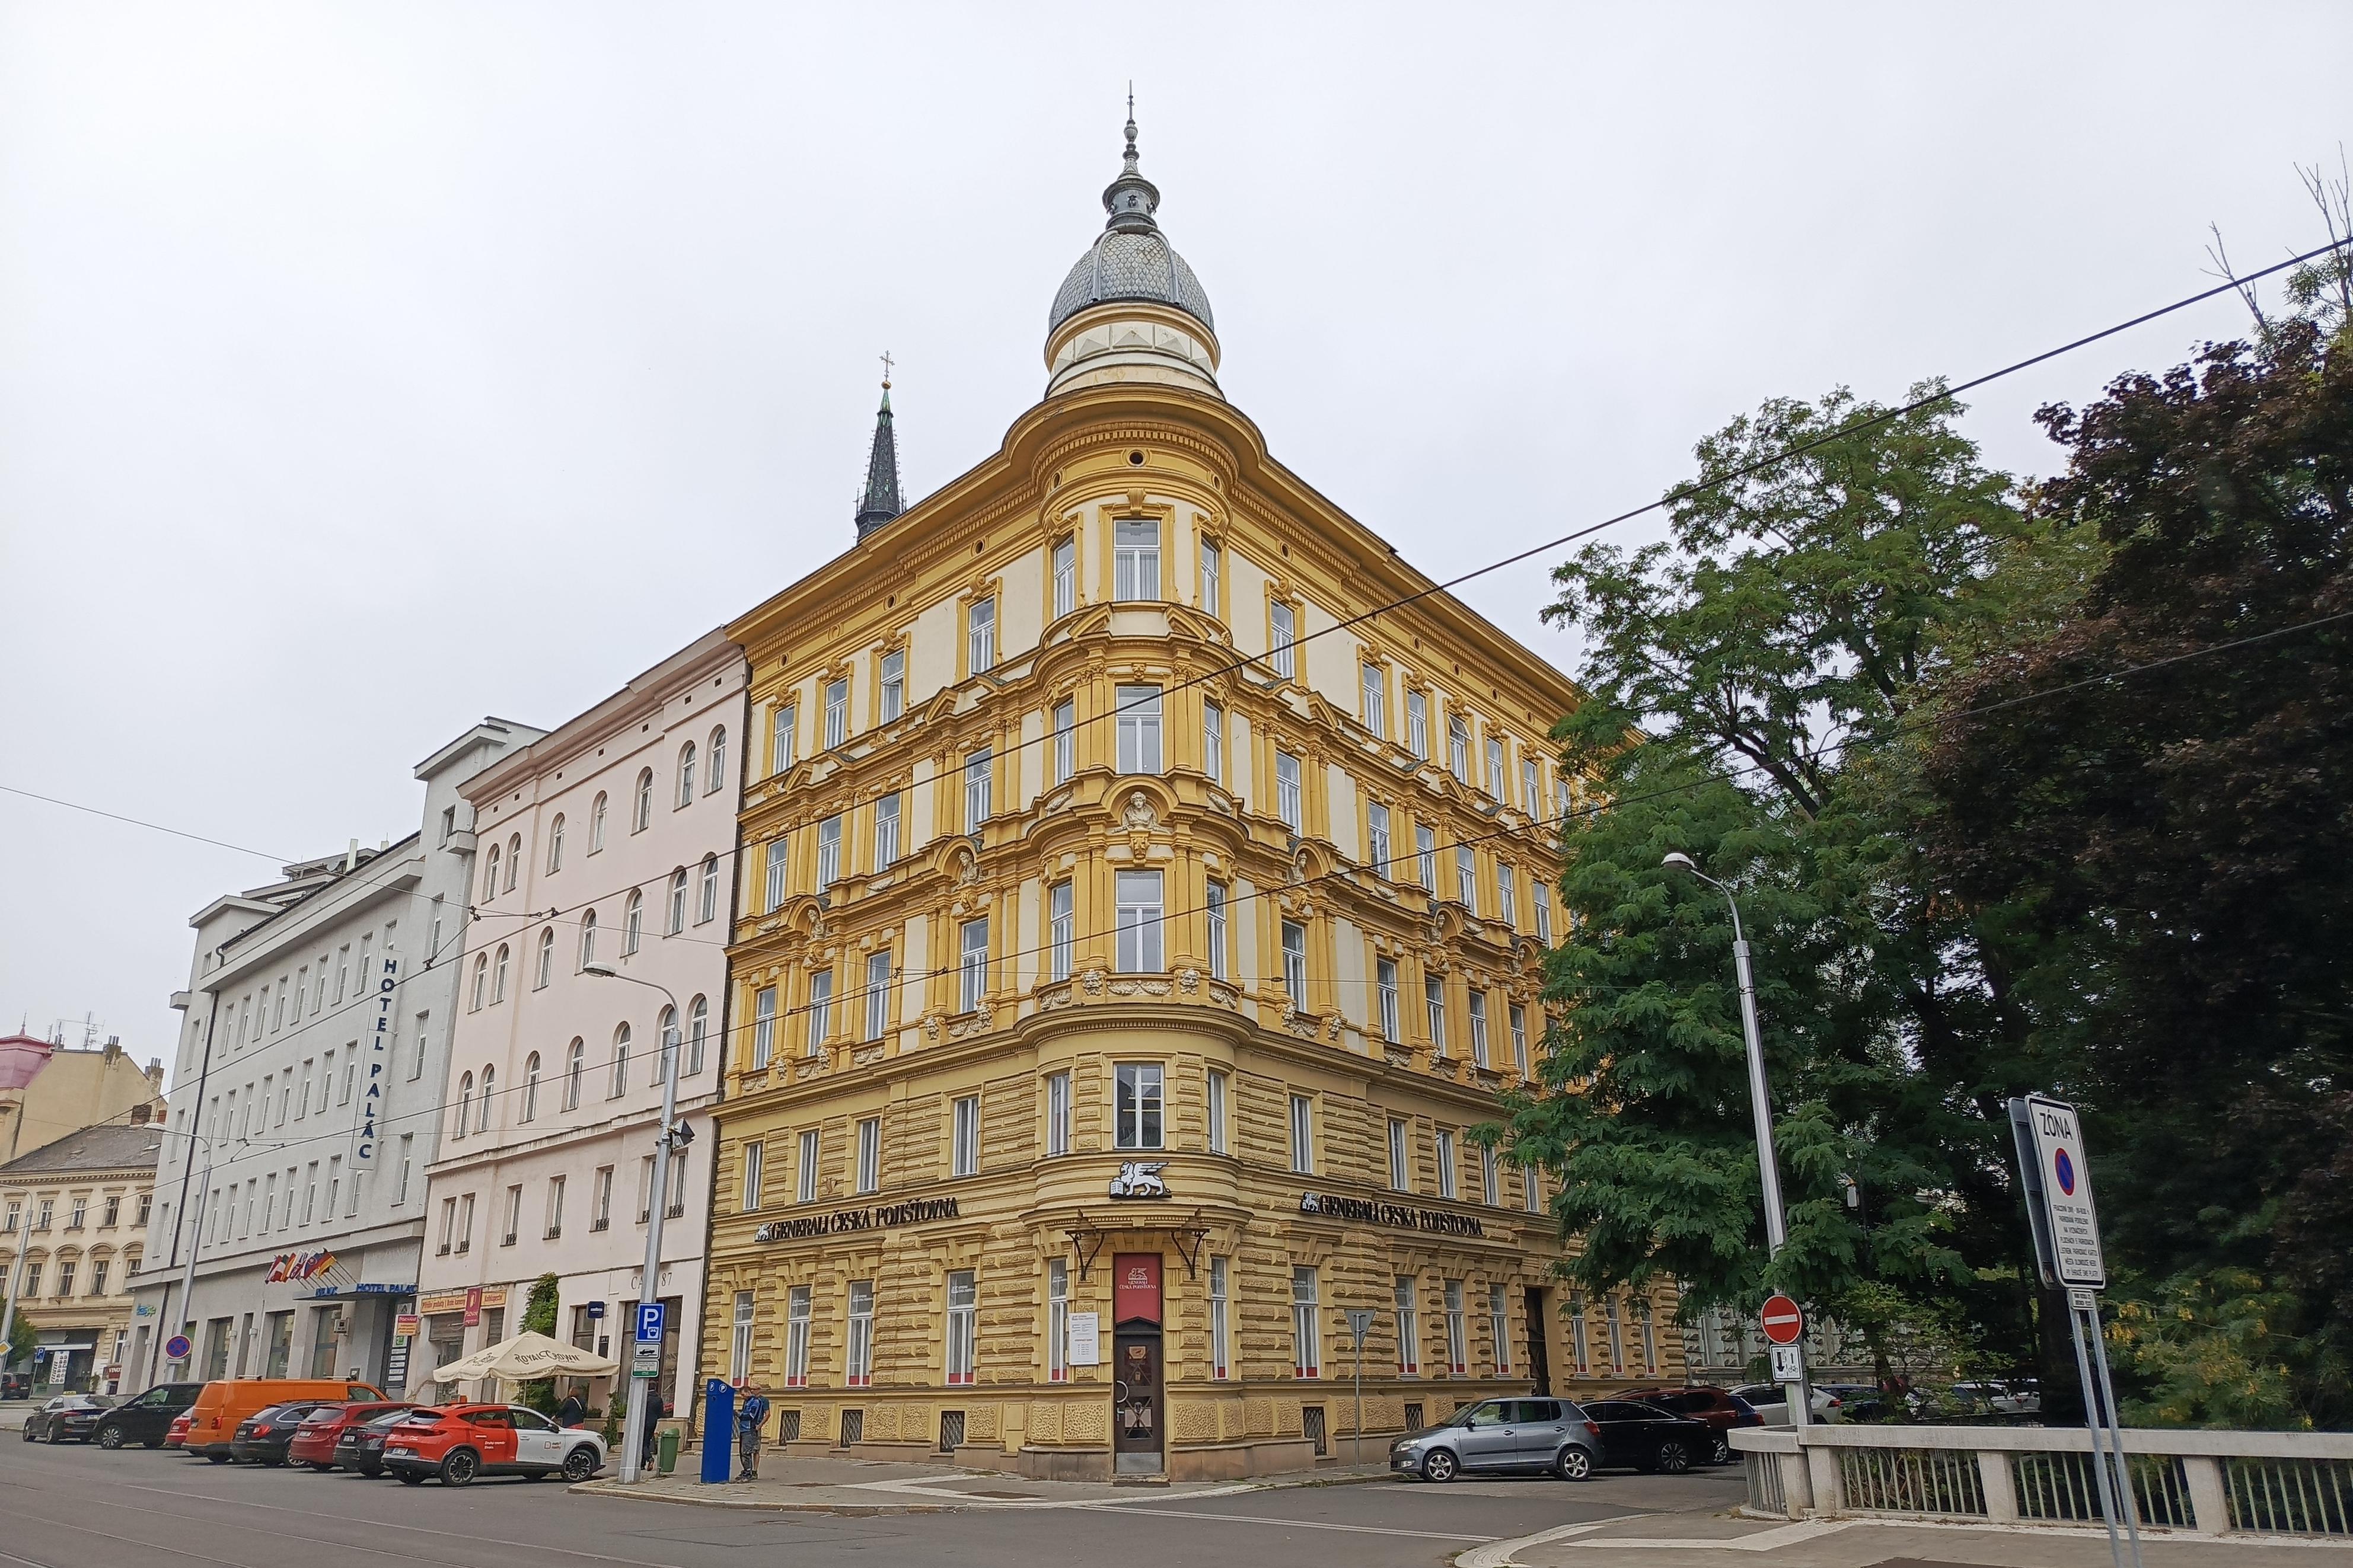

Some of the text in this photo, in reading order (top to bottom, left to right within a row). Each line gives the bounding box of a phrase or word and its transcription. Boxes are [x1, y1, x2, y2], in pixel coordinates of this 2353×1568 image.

[359, 959, 397, 1159] HOTEL PALÁC
[2039, 1109, 2073, 1141] ZÓNA
[771, 1197, 960, 1240] GENERALI ČESKÁ POJIŠŤOVNA
[1319, 1194, 1484, 1236] GENERALI ČESKÁ POJIŠŤOVNA
[356, 1283, 385, 1292] HOTEL
[661, 1272, 672, 1286] 87
[643, 1308, 659, 1330] P
[514, 1350, 580, 1365] ROYAL CROWN
